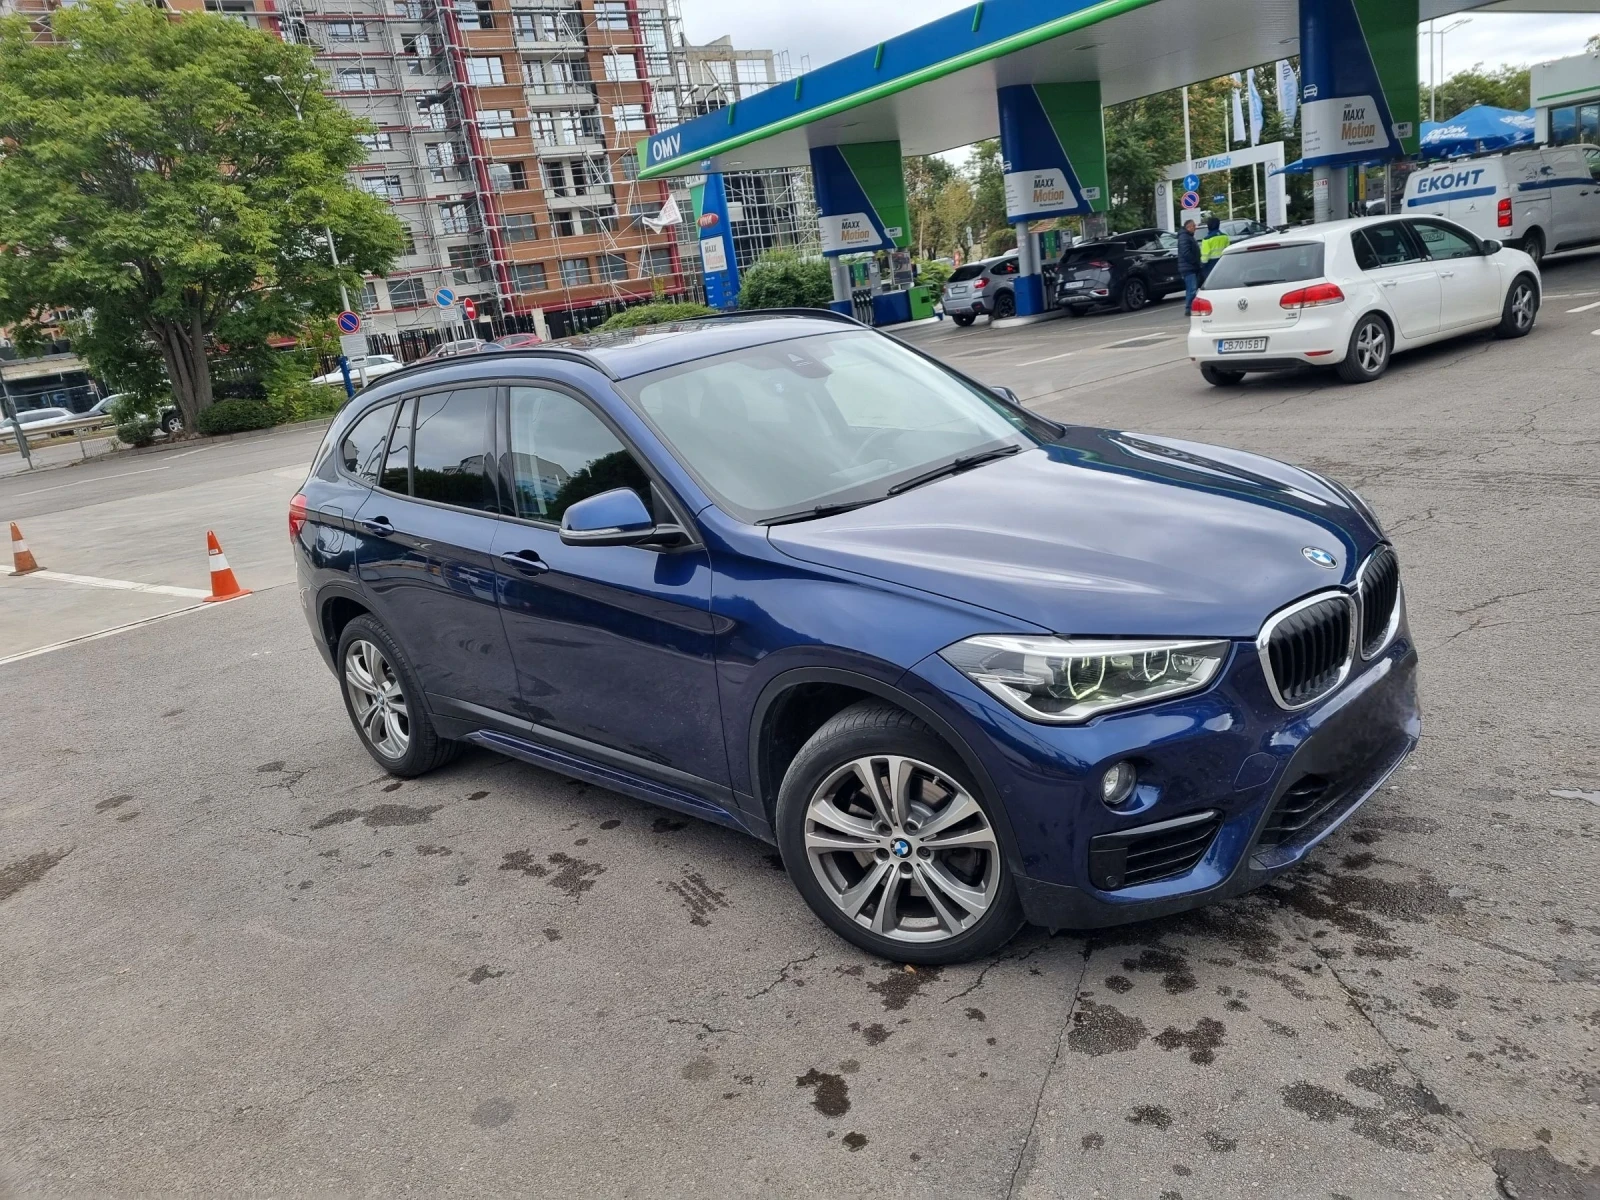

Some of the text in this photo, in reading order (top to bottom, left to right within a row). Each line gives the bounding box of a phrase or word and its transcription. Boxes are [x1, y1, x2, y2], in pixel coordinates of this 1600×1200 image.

[1343, 108, 1366, 121] MAXX
[1341, 121, 1376, 140] Motion
[652, 132, 681, 161] OMV
[1195, 156, 1232, 169] TOP Wash
[1033, 178, 1055, 189] MAXX
[1417, 168, 1485, 194] ЕКОНТ
[1032, 188, 1065, 203] Motion
[841, 220, 860, 230] MAXX
[841, 229, 870, 241] Motion
